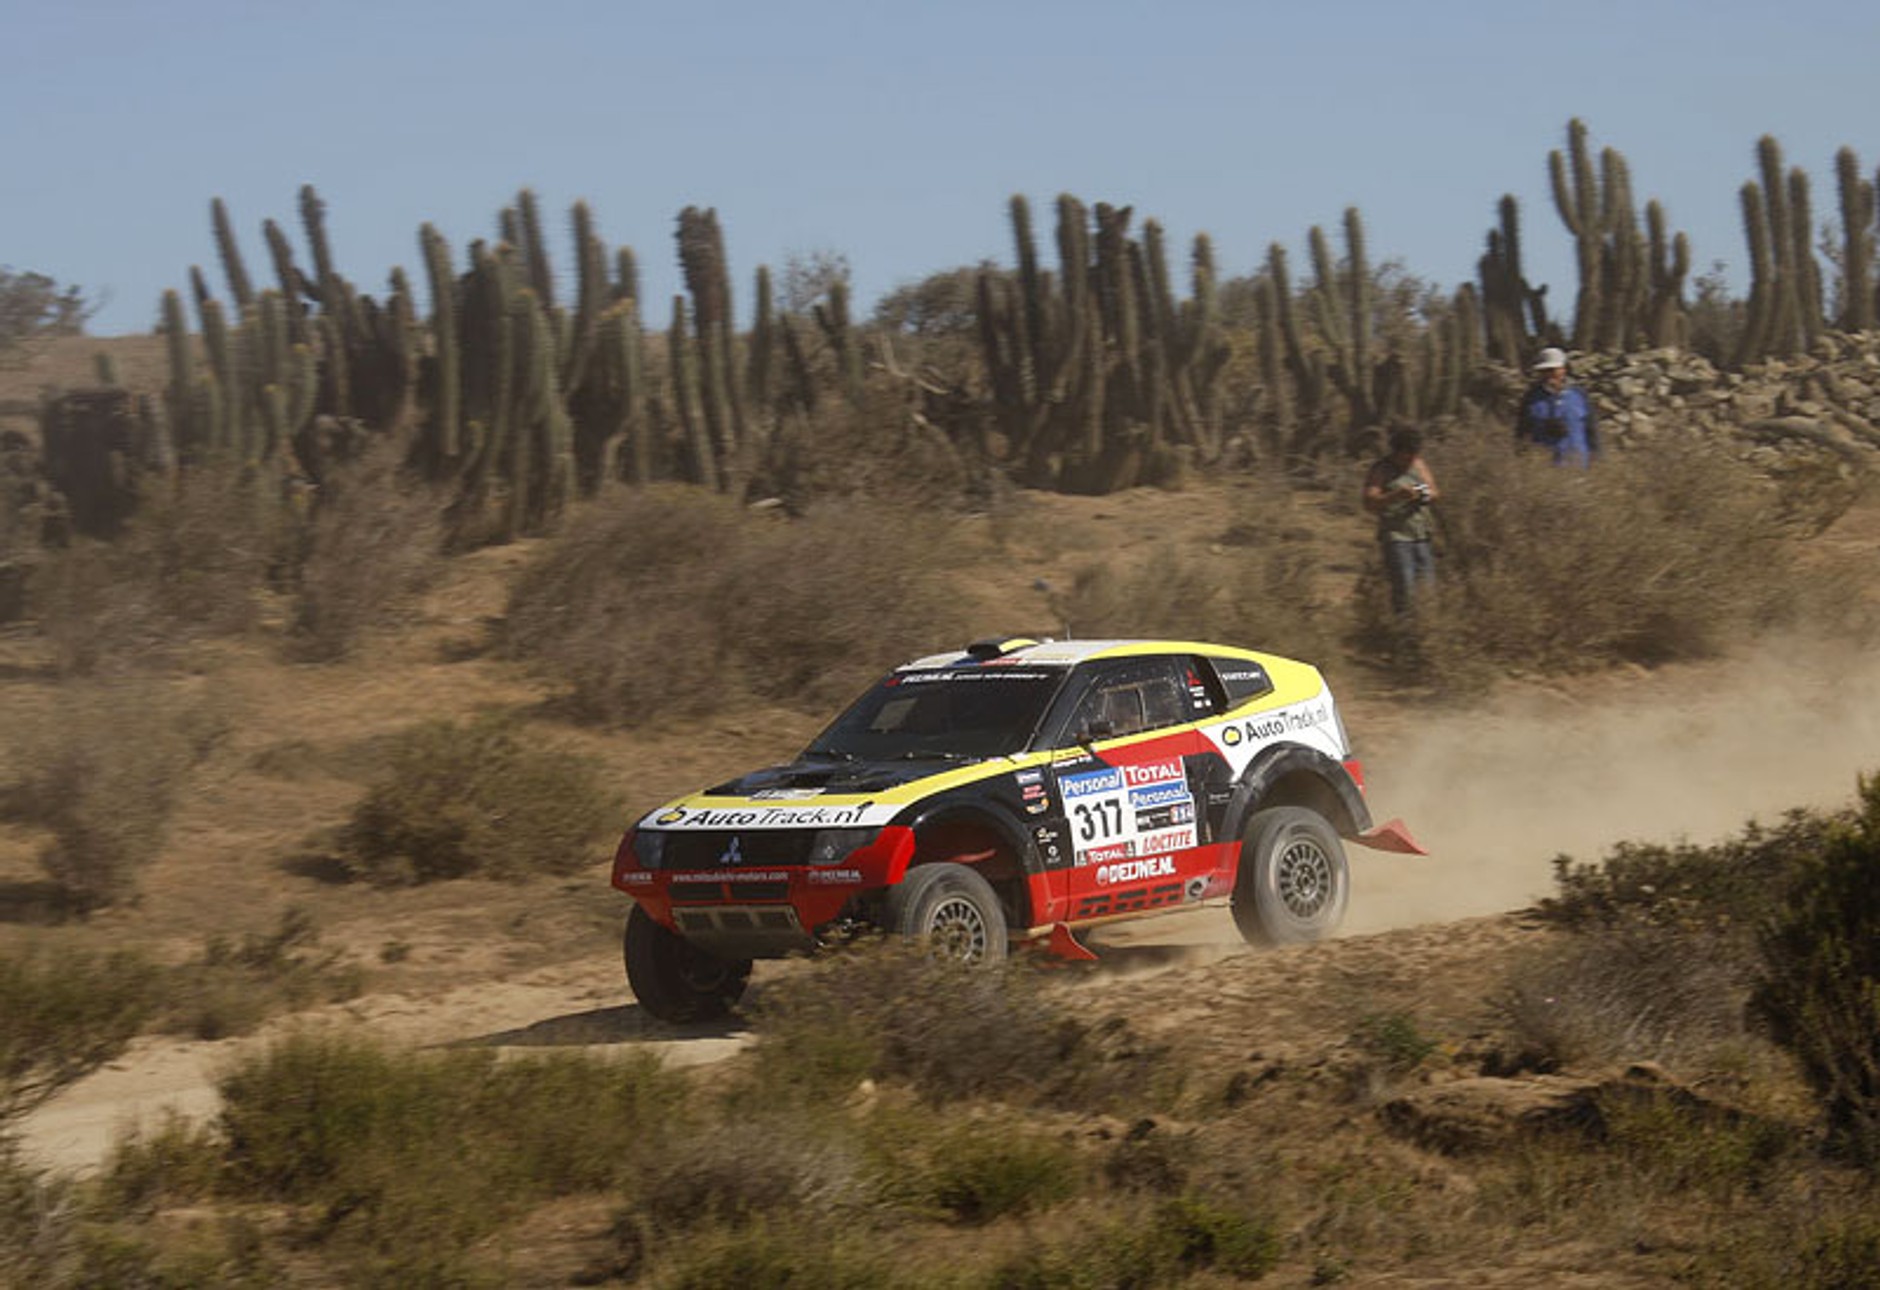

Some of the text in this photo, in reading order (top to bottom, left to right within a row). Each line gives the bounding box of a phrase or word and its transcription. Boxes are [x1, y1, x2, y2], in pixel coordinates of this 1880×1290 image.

[1246, 704, 1329, 742] AutoTrack.nl
[1064, 768, 1121, 796] Personal
[1126, 763, 1181, 783] TOTAL
[684, 801, 875, 826] AutoTrack.nl
[1074, 798, 1122, 841] 317
[1142, 830, 1193, 854] LOCTITE
[1089, 848, 1124, 864] TOTAL
